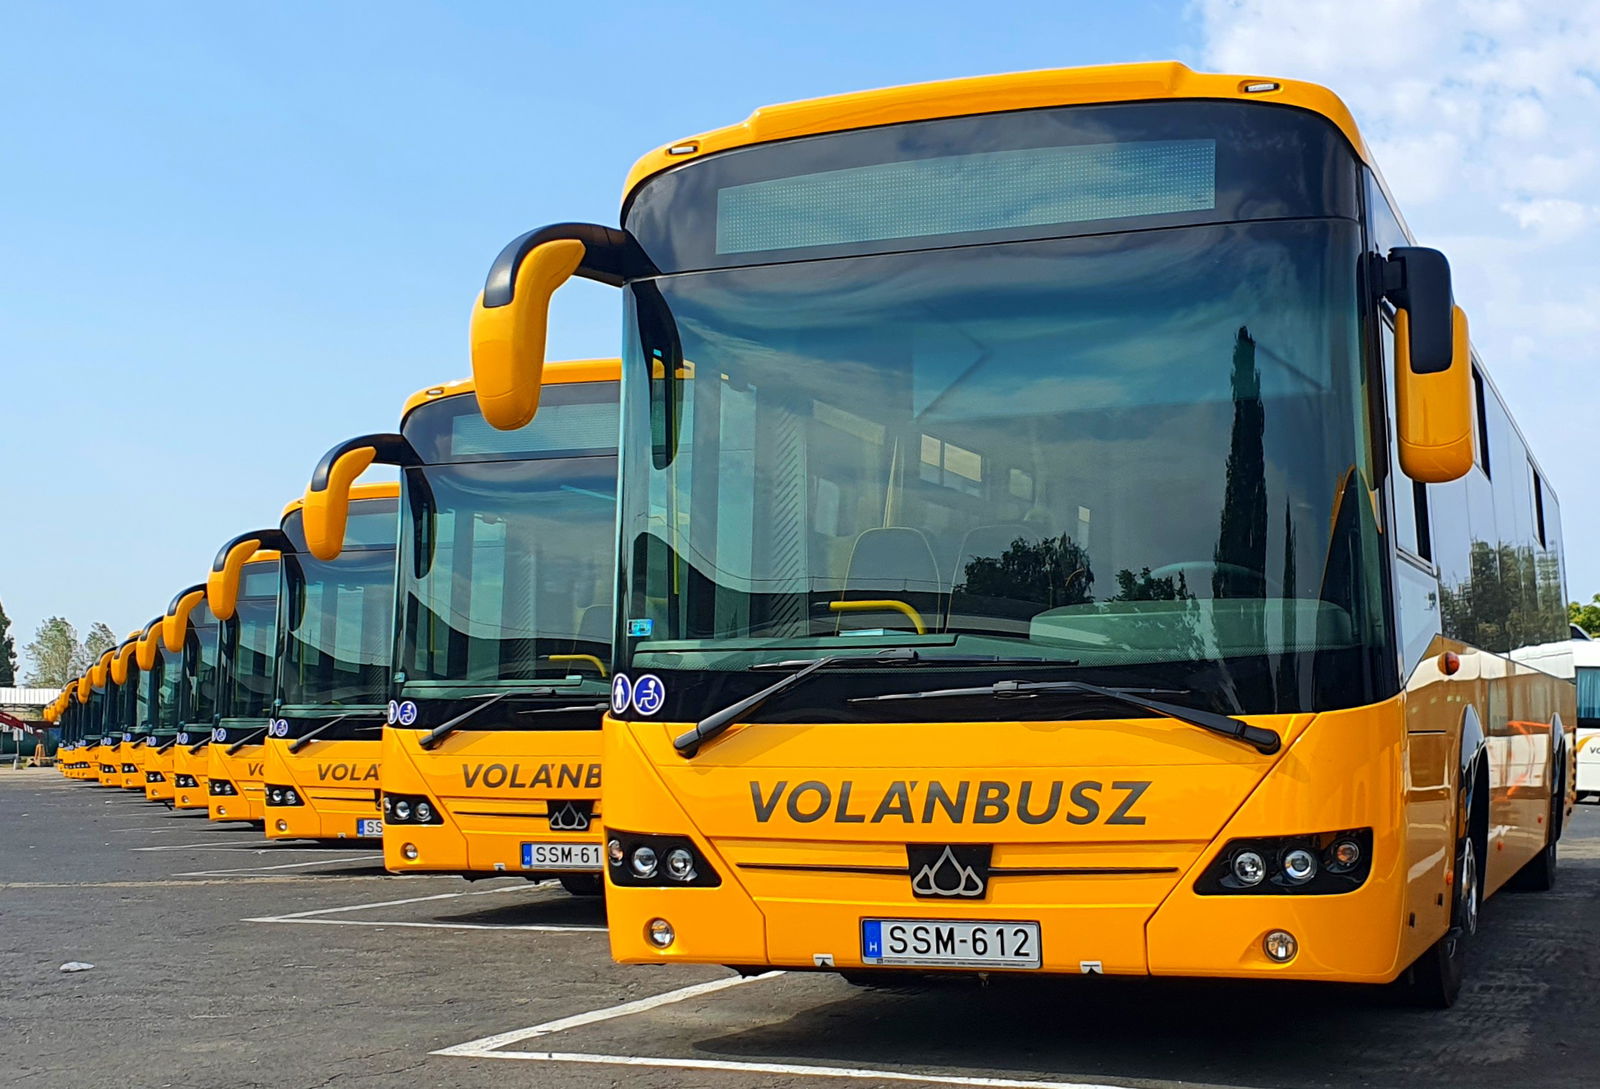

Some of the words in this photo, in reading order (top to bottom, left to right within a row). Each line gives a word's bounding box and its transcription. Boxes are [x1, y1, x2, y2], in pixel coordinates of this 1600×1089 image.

[749, 780, 1153, 825] VOLÁNBUSZ
[536, 846, 599, 863] SSM-61
[869, 942, 878, 952] H
[889, 925, 1030, 957] SSM-612
